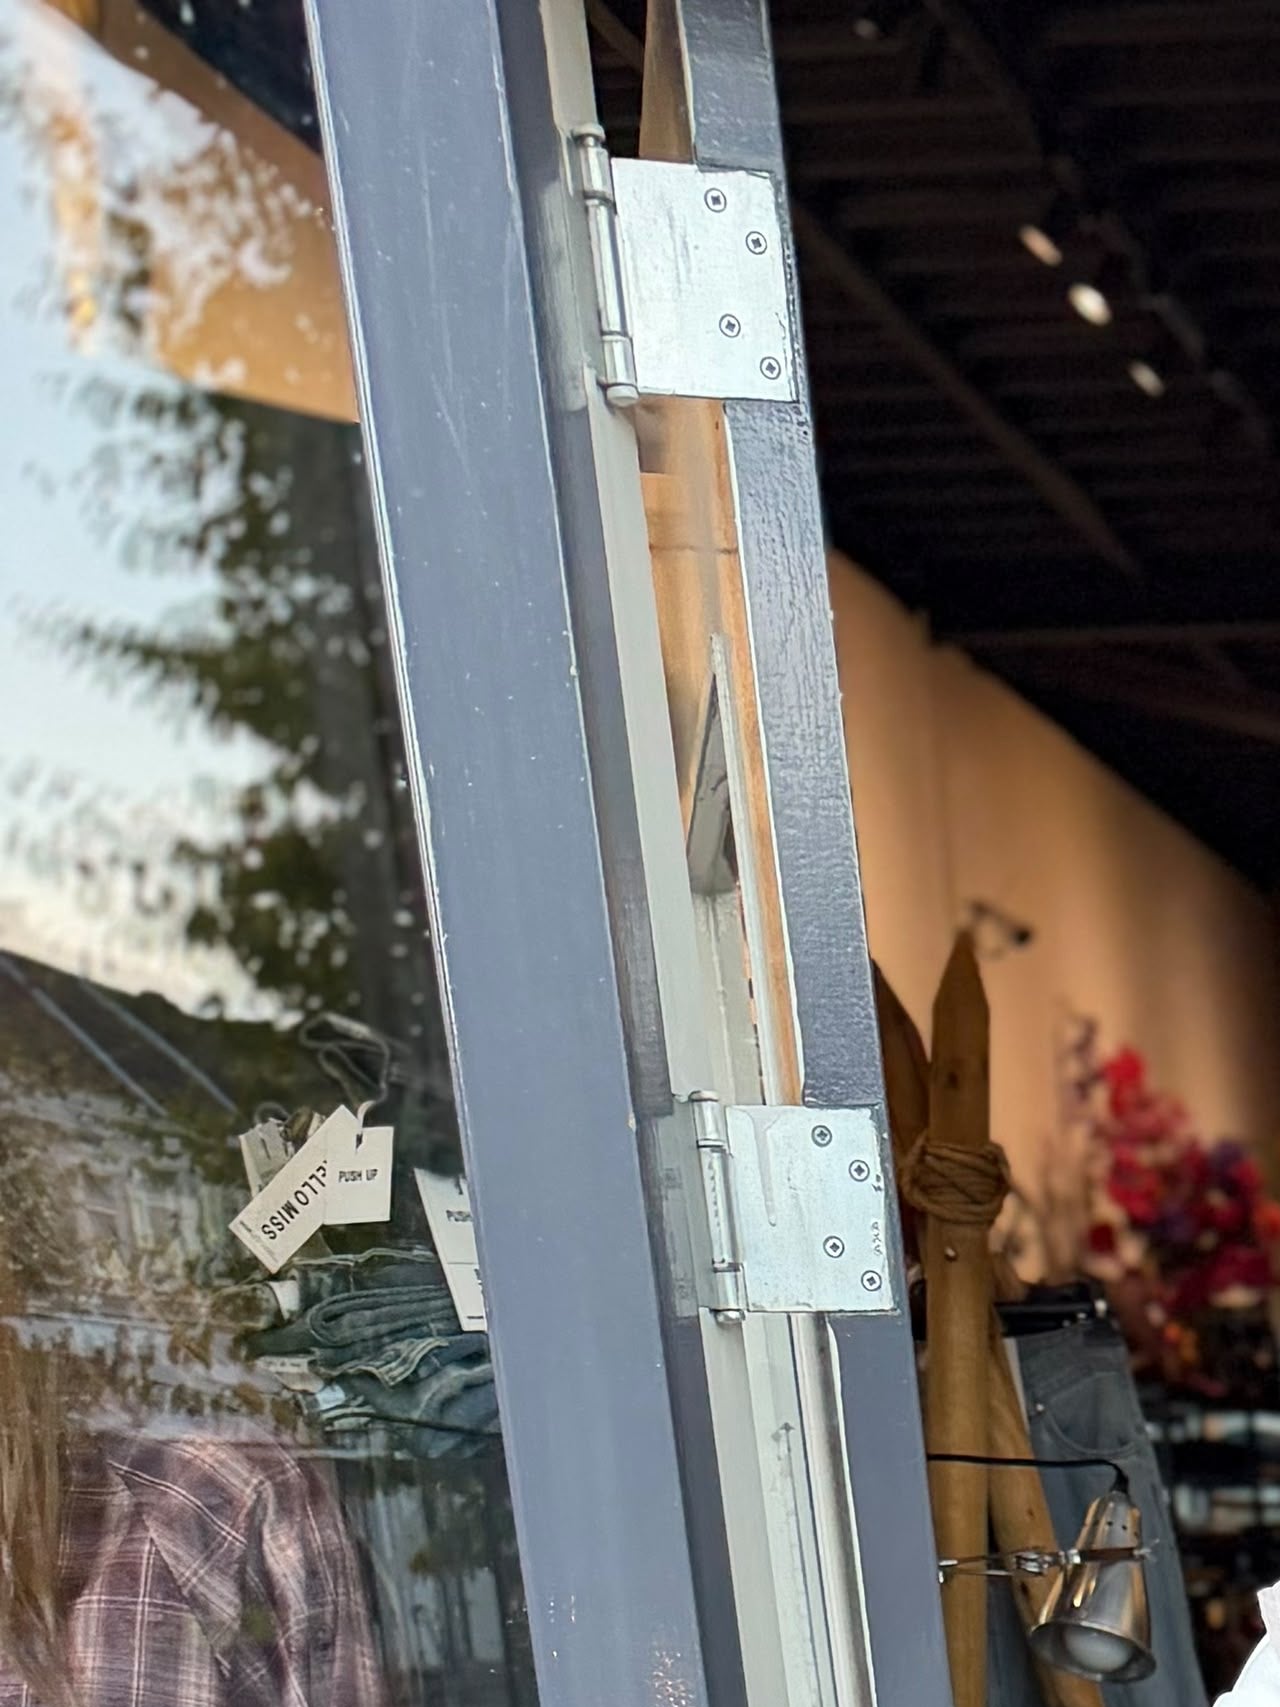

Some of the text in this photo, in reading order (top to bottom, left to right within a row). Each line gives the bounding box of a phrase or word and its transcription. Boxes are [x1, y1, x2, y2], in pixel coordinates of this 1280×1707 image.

[261, 1159, 328, 1240] ELLO MISS
[338, 1170, 362, 1183] PUSH
